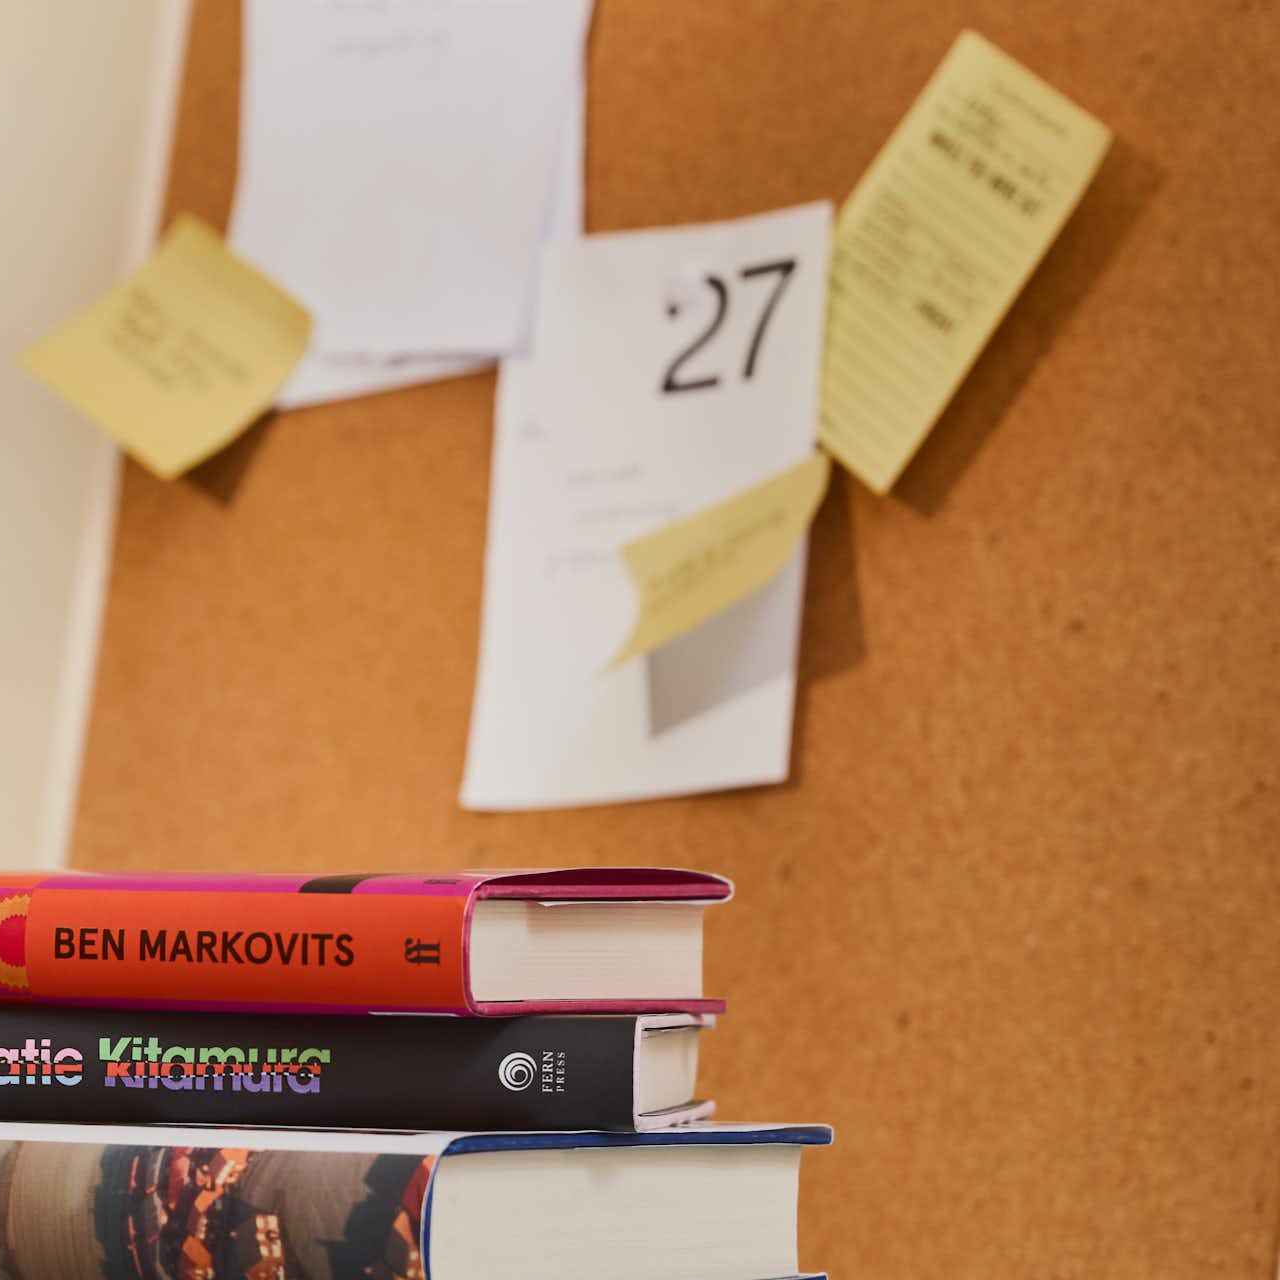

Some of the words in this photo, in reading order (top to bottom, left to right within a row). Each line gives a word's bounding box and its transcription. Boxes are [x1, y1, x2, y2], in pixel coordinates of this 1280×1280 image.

[662, 259, 797, 393] 27
[53, 927, 126, 961] BEN
[138, 929, 354, 967] MARKOVITS
[98, 1036, 331, 1094] Kitamura
[541, 1051, 554, 1092] FERN
[556, 1052, 566, 1092] PRESS
